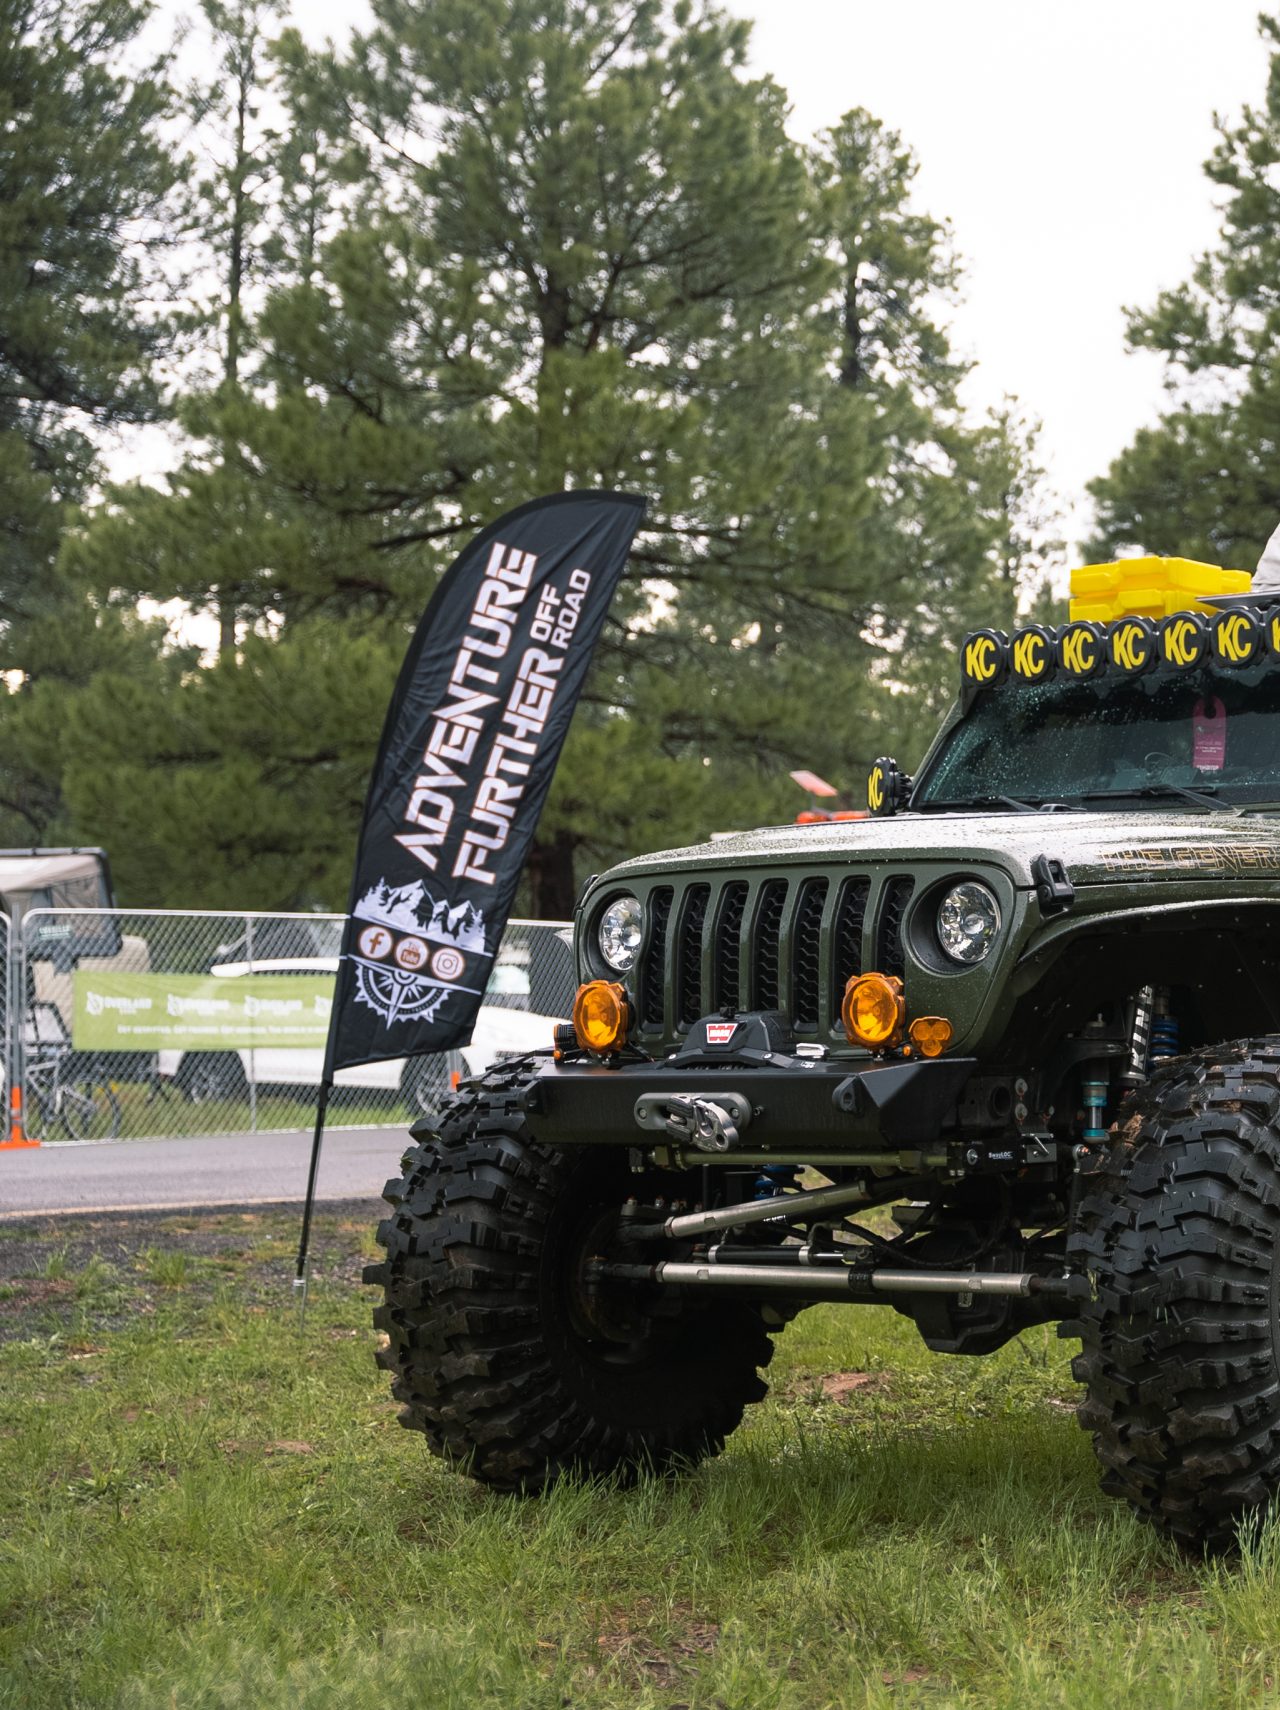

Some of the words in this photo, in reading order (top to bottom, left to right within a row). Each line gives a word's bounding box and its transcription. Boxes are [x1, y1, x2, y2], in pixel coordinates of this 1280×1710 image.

[530, 584, 560, 642] OFF
[550, 569, 591, 650] ROAD
[966, 637, 996, 681] KC
[1014, 633, 1044, 677] KC
[1063, 629, 1094, 674] KC
[1113, 624, 1145, 670] KC
[1164, 620, 1197, 665] KC
[1218, 615, 1251, 661] KC
[393, 542, 539, 871] ADVENTURE
[452, 648, 564, 885] FURTHER
[868, 766, 883, 811] KC
[1100, 847, 1168, 872] THE
